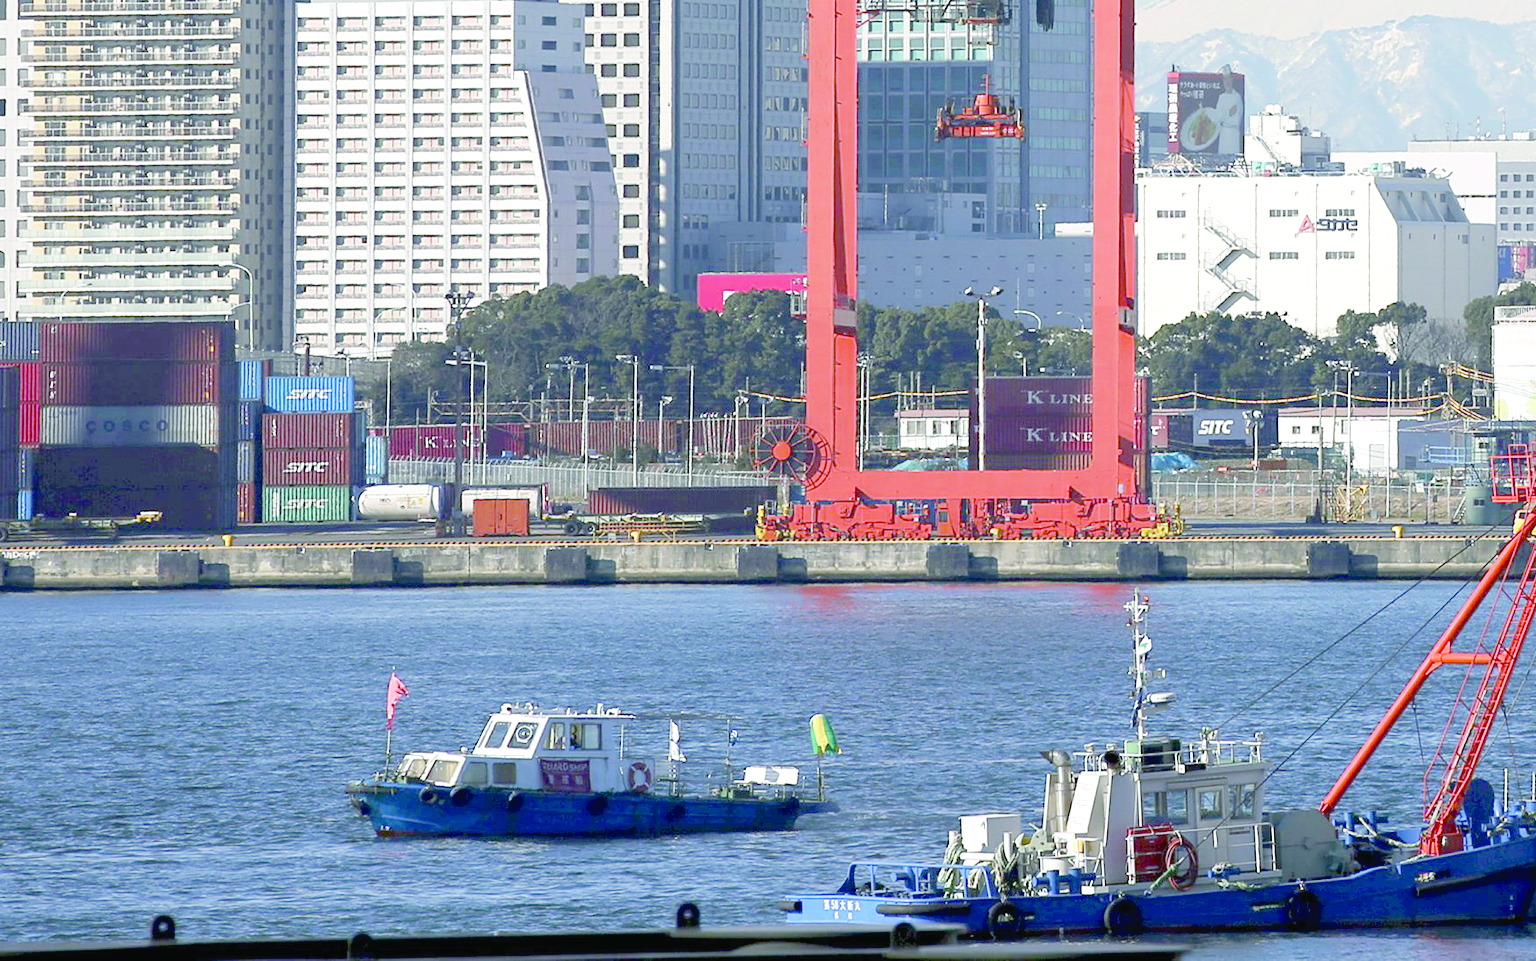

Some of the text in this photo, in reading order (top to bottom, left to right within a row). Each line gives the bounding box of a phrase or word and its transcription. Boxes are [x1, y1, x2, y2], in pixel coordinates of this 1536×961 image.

[286, 389, 333, 400] SITC
[1050, 394, 1093, 404] LINE
[86, 420, 168, 431] COSCO
[1198, 420, 1234, 435] SITC
[1050, 431, 1093, 442] LINE
[282, 461, 329, 473] SITC
[281, 498, 329, 509] SITC
